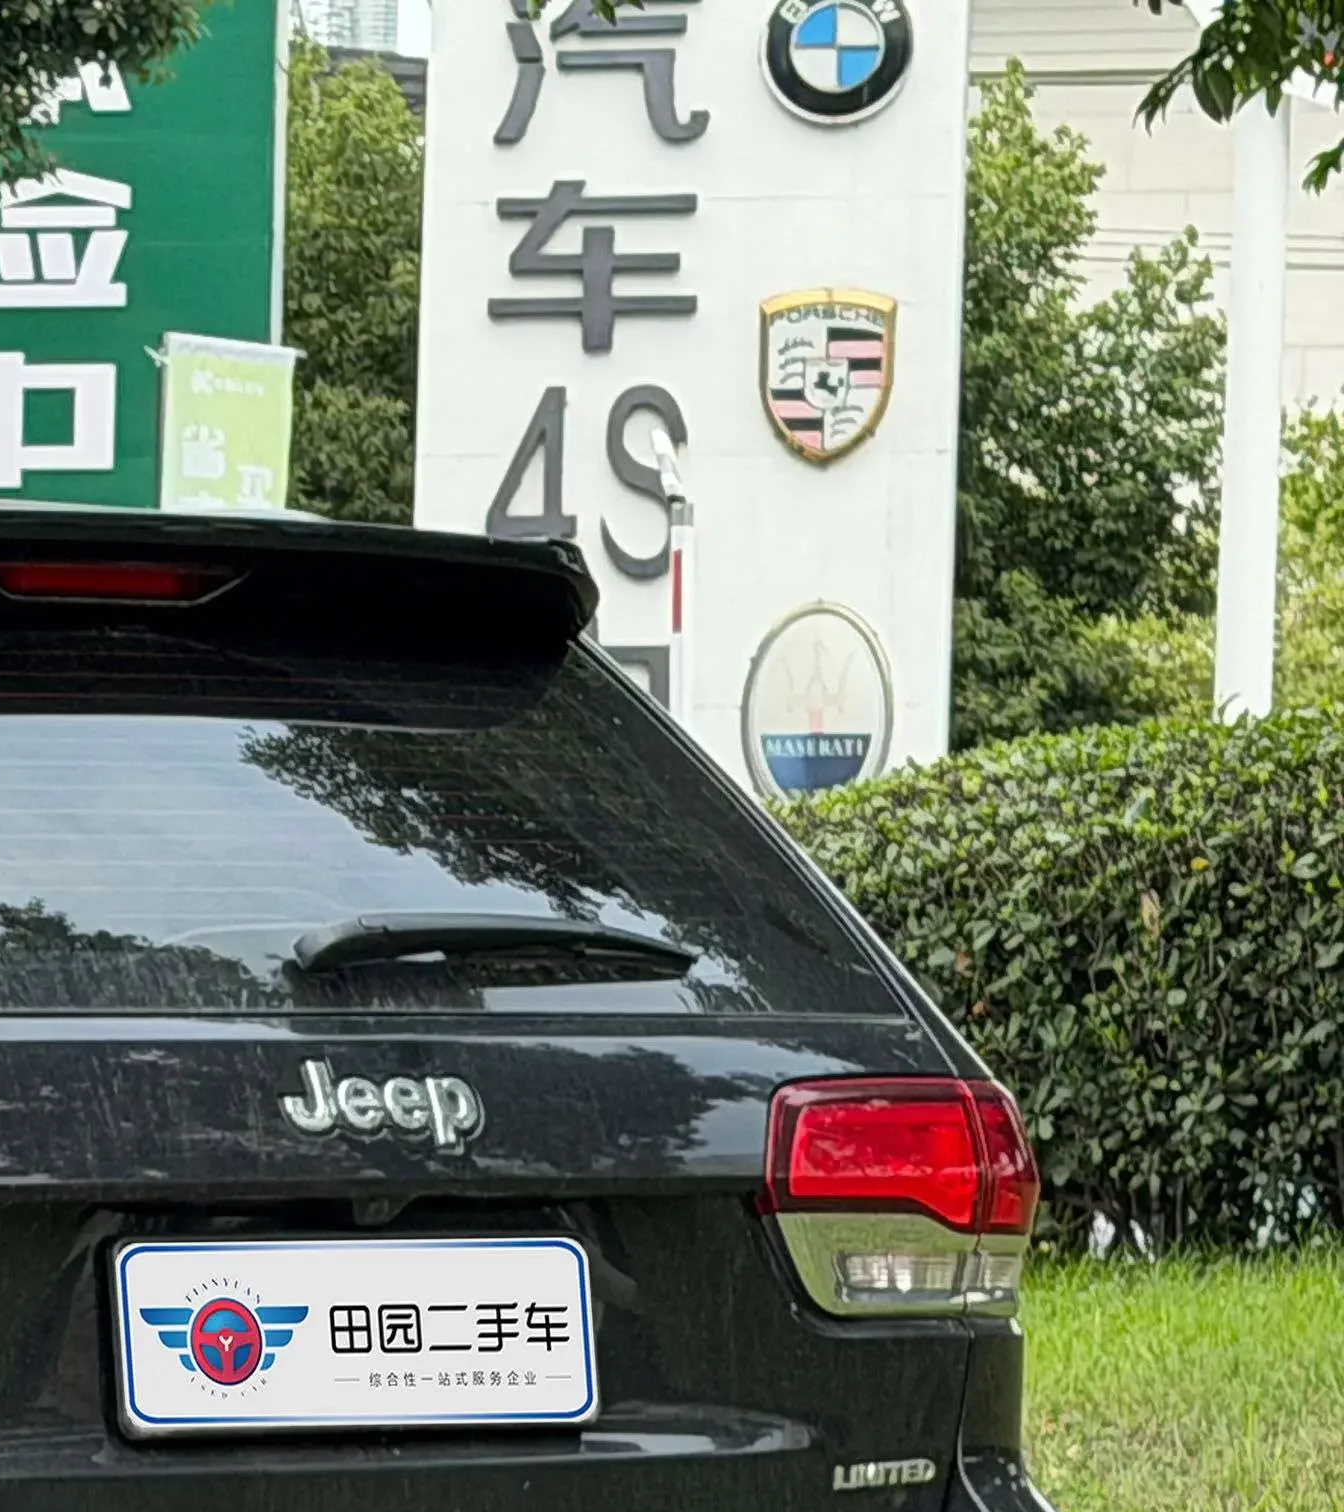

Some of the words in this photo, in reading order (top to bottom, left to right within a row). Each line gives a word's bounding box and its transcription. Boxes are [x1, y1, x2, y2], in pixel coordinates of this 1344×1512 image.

[485, 0, 711, 712] 汽车4S
[765, 737, 864, 757] MASERATI
[282, 1056, 480, 1148] Jeep
[329, 1302, 570, 1354] 田园二手车
[368, 1370, 537, 1388] 综合性一站式服务企业
